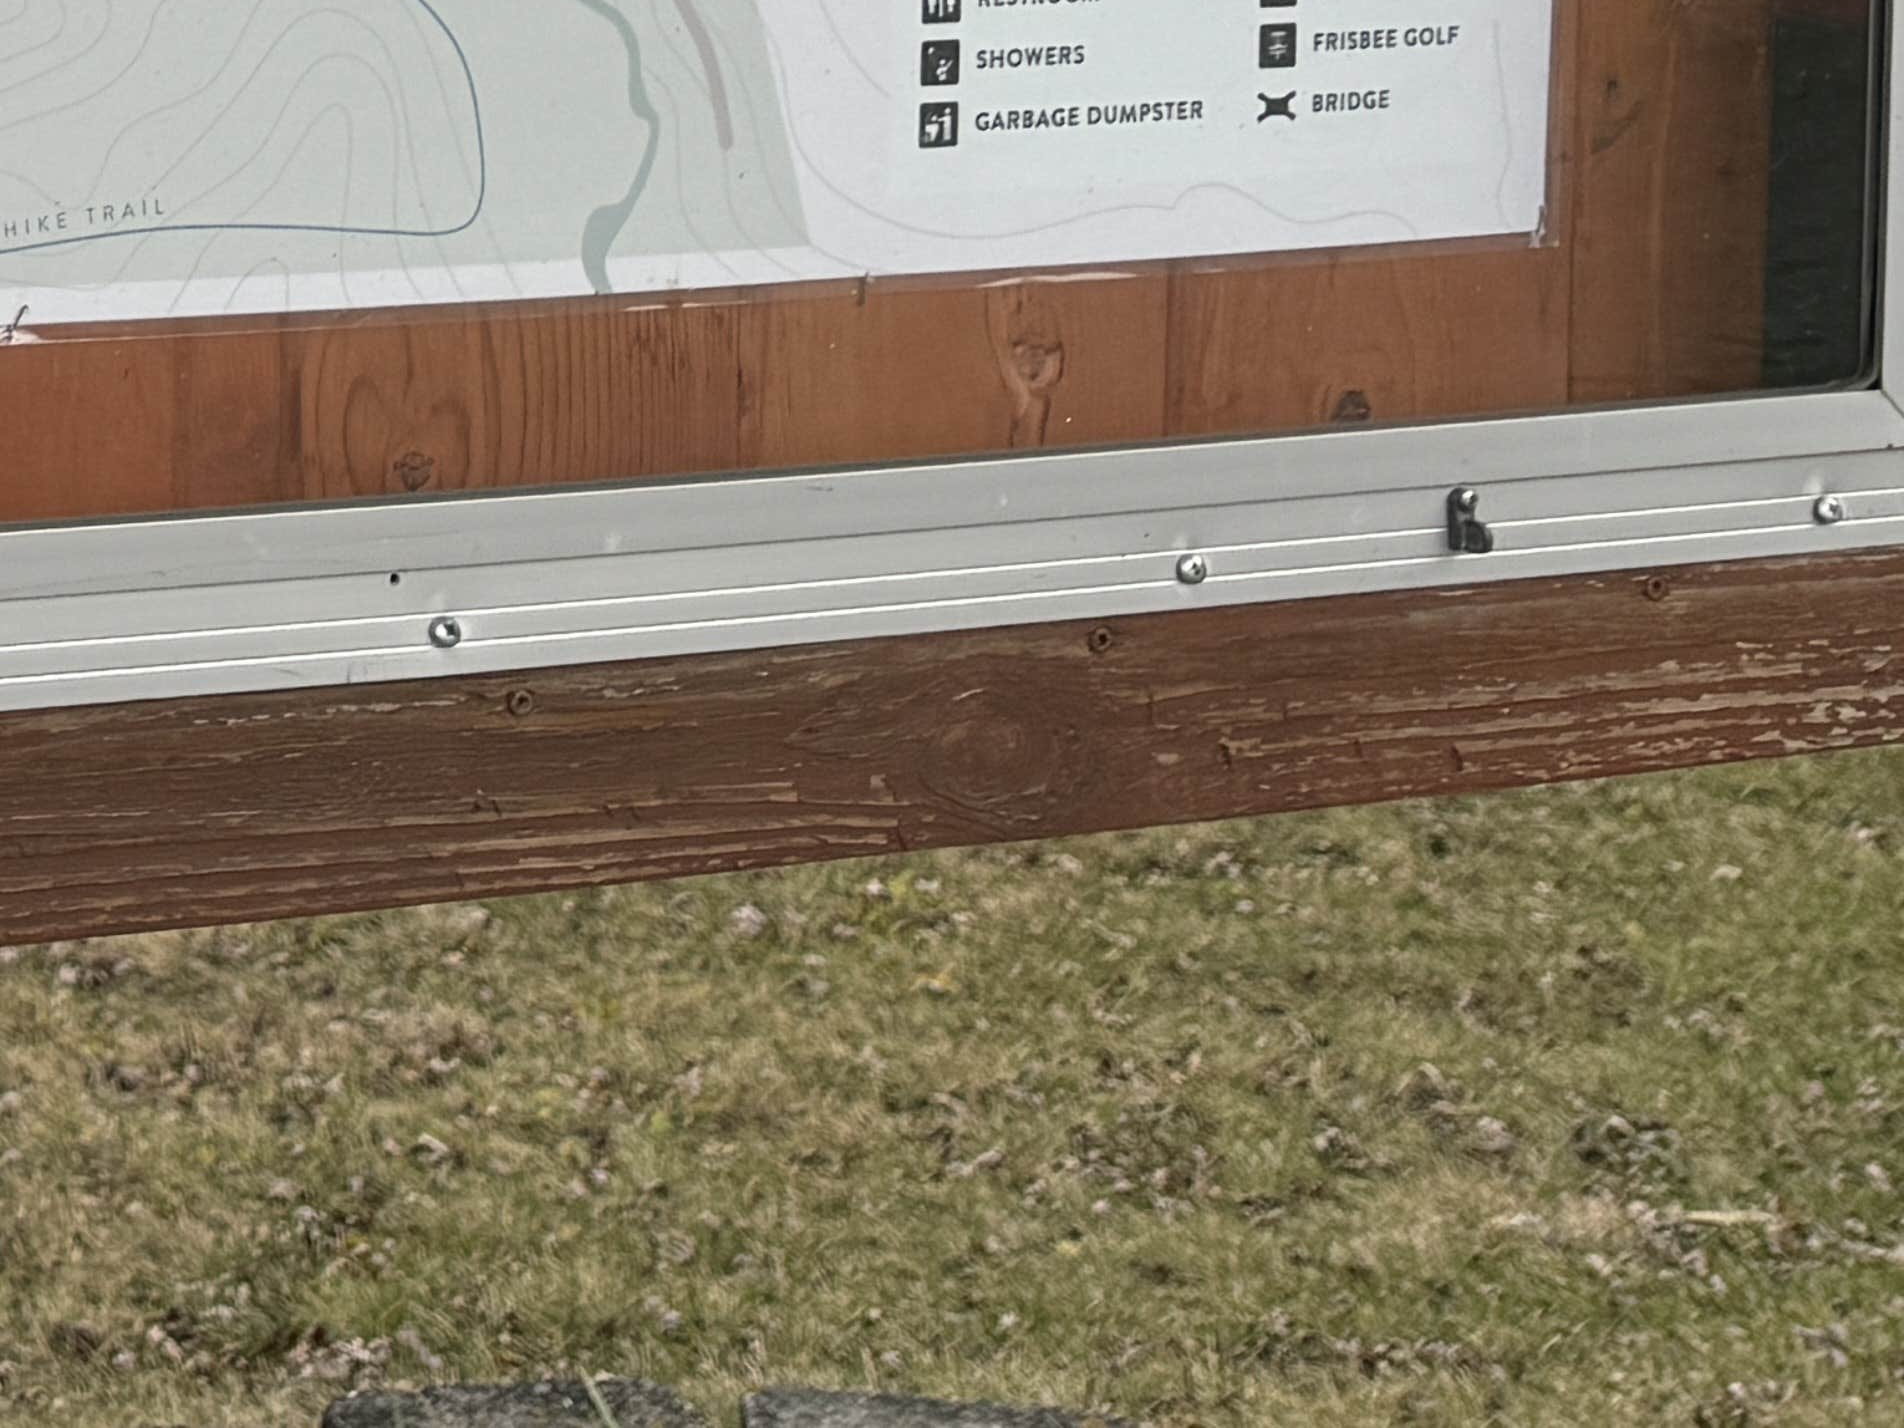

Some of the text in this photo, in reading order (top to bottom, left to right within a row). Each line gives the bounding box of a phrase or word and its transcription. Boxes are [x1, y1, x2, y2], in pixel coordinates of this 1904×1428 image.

[1313, 25, 1460, 51] FRISBEE GOLF
[976, 45, 1085, 69] SHOWERS
[1311, 89, 1390, 113] BRIDGE
[975, 99, 1204, 131] GARBAGE DUMPSTER
[4, 211, 67, 237] HIKE
[86, 199, 165, 225] TRAIL
